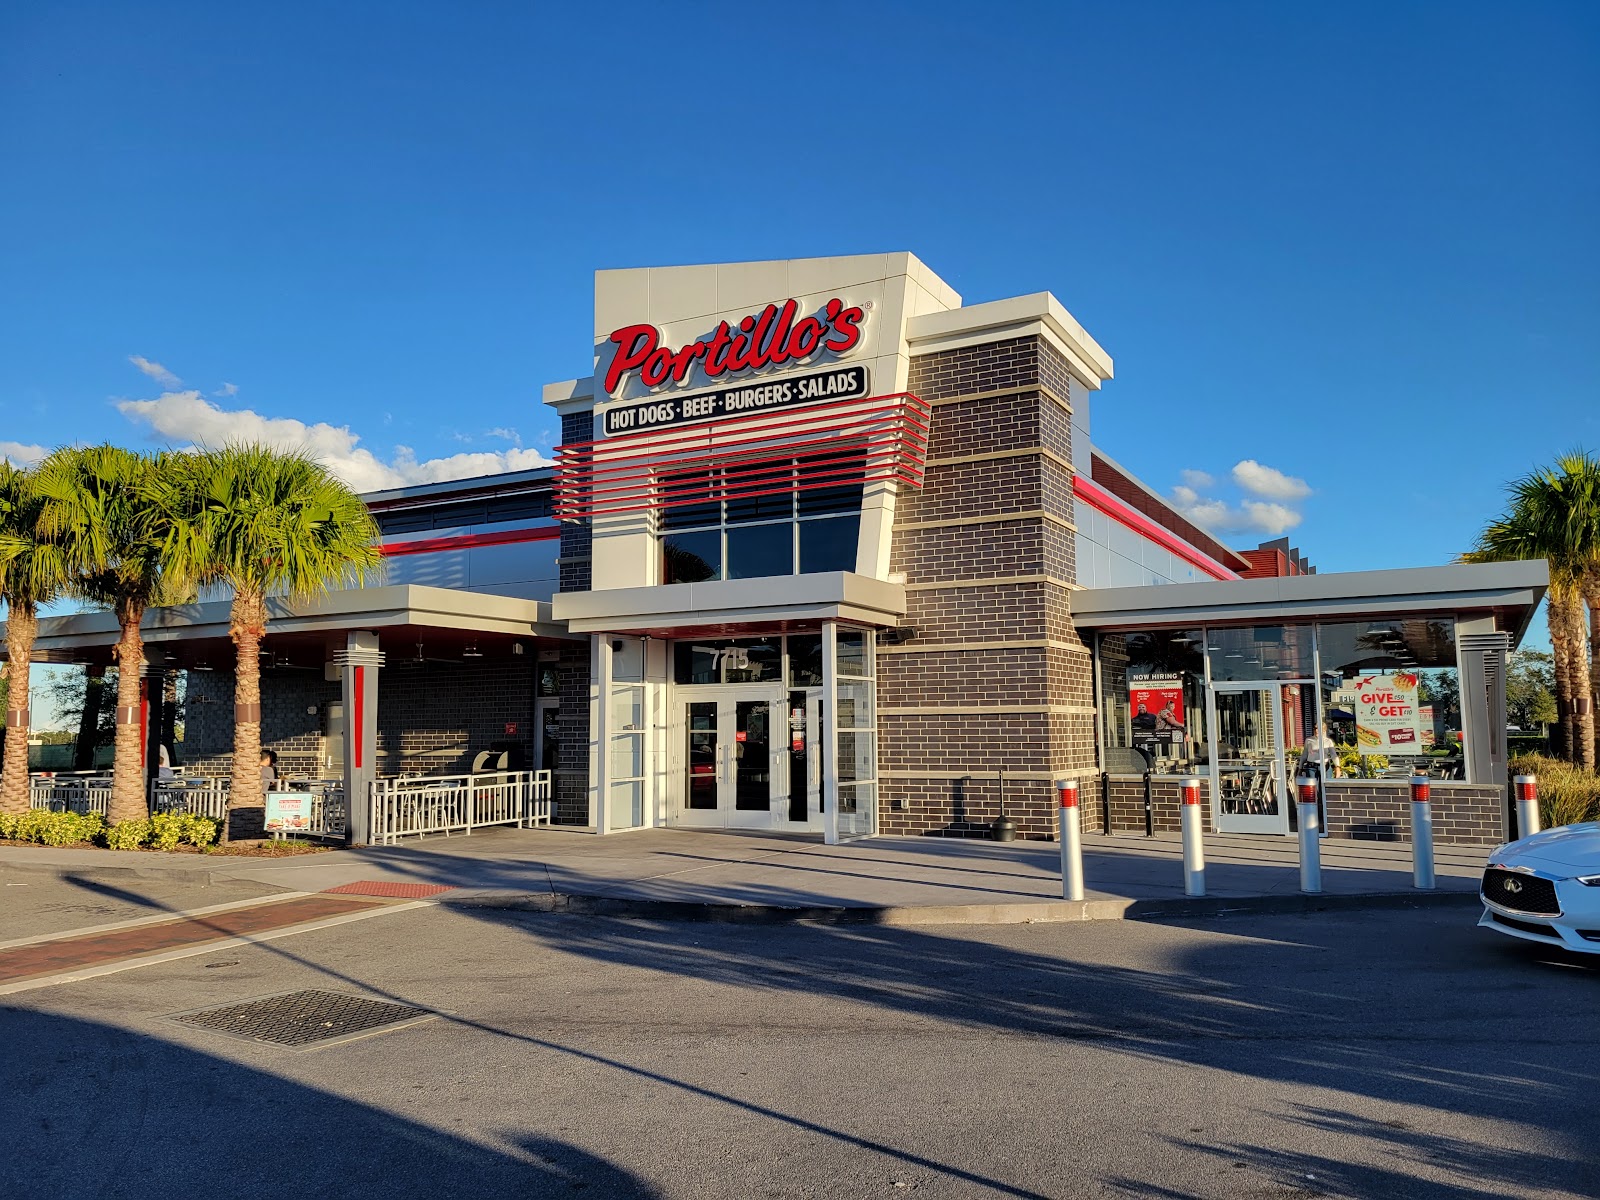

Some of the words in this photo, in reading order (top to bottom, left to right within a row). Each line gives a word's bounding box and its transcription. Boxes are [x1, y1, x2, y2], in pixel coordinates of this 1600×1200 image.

[604, 298, 864, 394] Portillo's
[610, 409, 635, 429] HOT
[638, 403, 675, 425] DOGS
[682, 394, 717, 418] BEEF
[725, 383, 792, 411] BURGERS
[798, 372, 858, 399] SALADS
[709, 648, 749, 670] 7715
[1361, 693, 1404, 704] GIVE
[1379, 706, 1410, 717] GET
